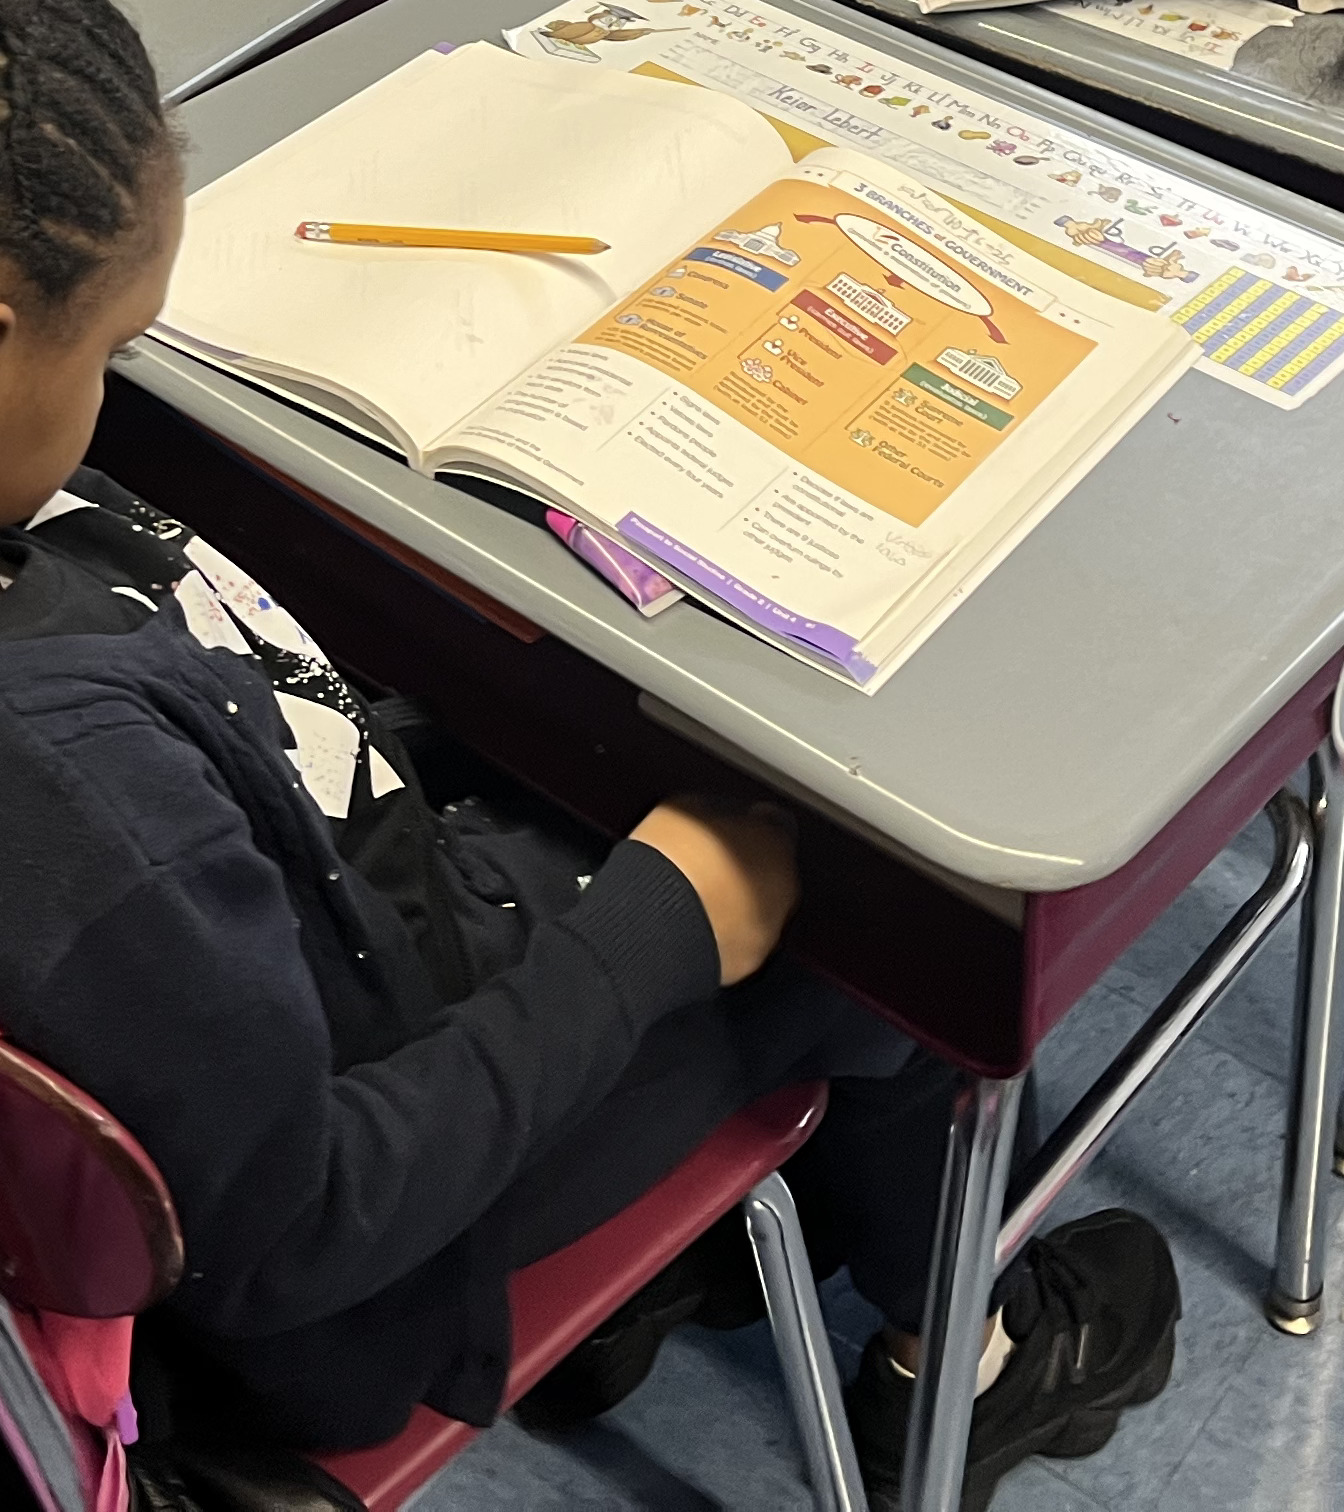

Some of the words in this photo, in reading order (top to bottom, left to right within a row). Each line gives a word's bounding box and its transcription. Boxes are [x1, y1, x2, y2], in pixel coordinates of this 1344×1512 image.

[723, 4, 750, 18] Dd
[799, 37, 823, 54] Gg
[827, 49, 850, 64] Hh
[947, 99, 976, 119] Mm
[977, 113, 1002, 131] Nn
[1006, 125, 1031, 143] Oo
[853, 182, 869, 194] 3
[865, 188, 935, 236] BRANCHES
[944, 237, 1035, 297] GOVERNMENT
[1105, 217, 1126, 239] b
[1147, 240, 1178, 257] d
[891, 243, 962, 293] Constitution
[799, 327, 843, 360] President
[914, 406, 945, 425] Court
[872, 445, 911, 470] Federal
[909, 465, 945, 489] Courts
[877, 439, 909, 459] Other
[733, 582, 758, 601] Grade
